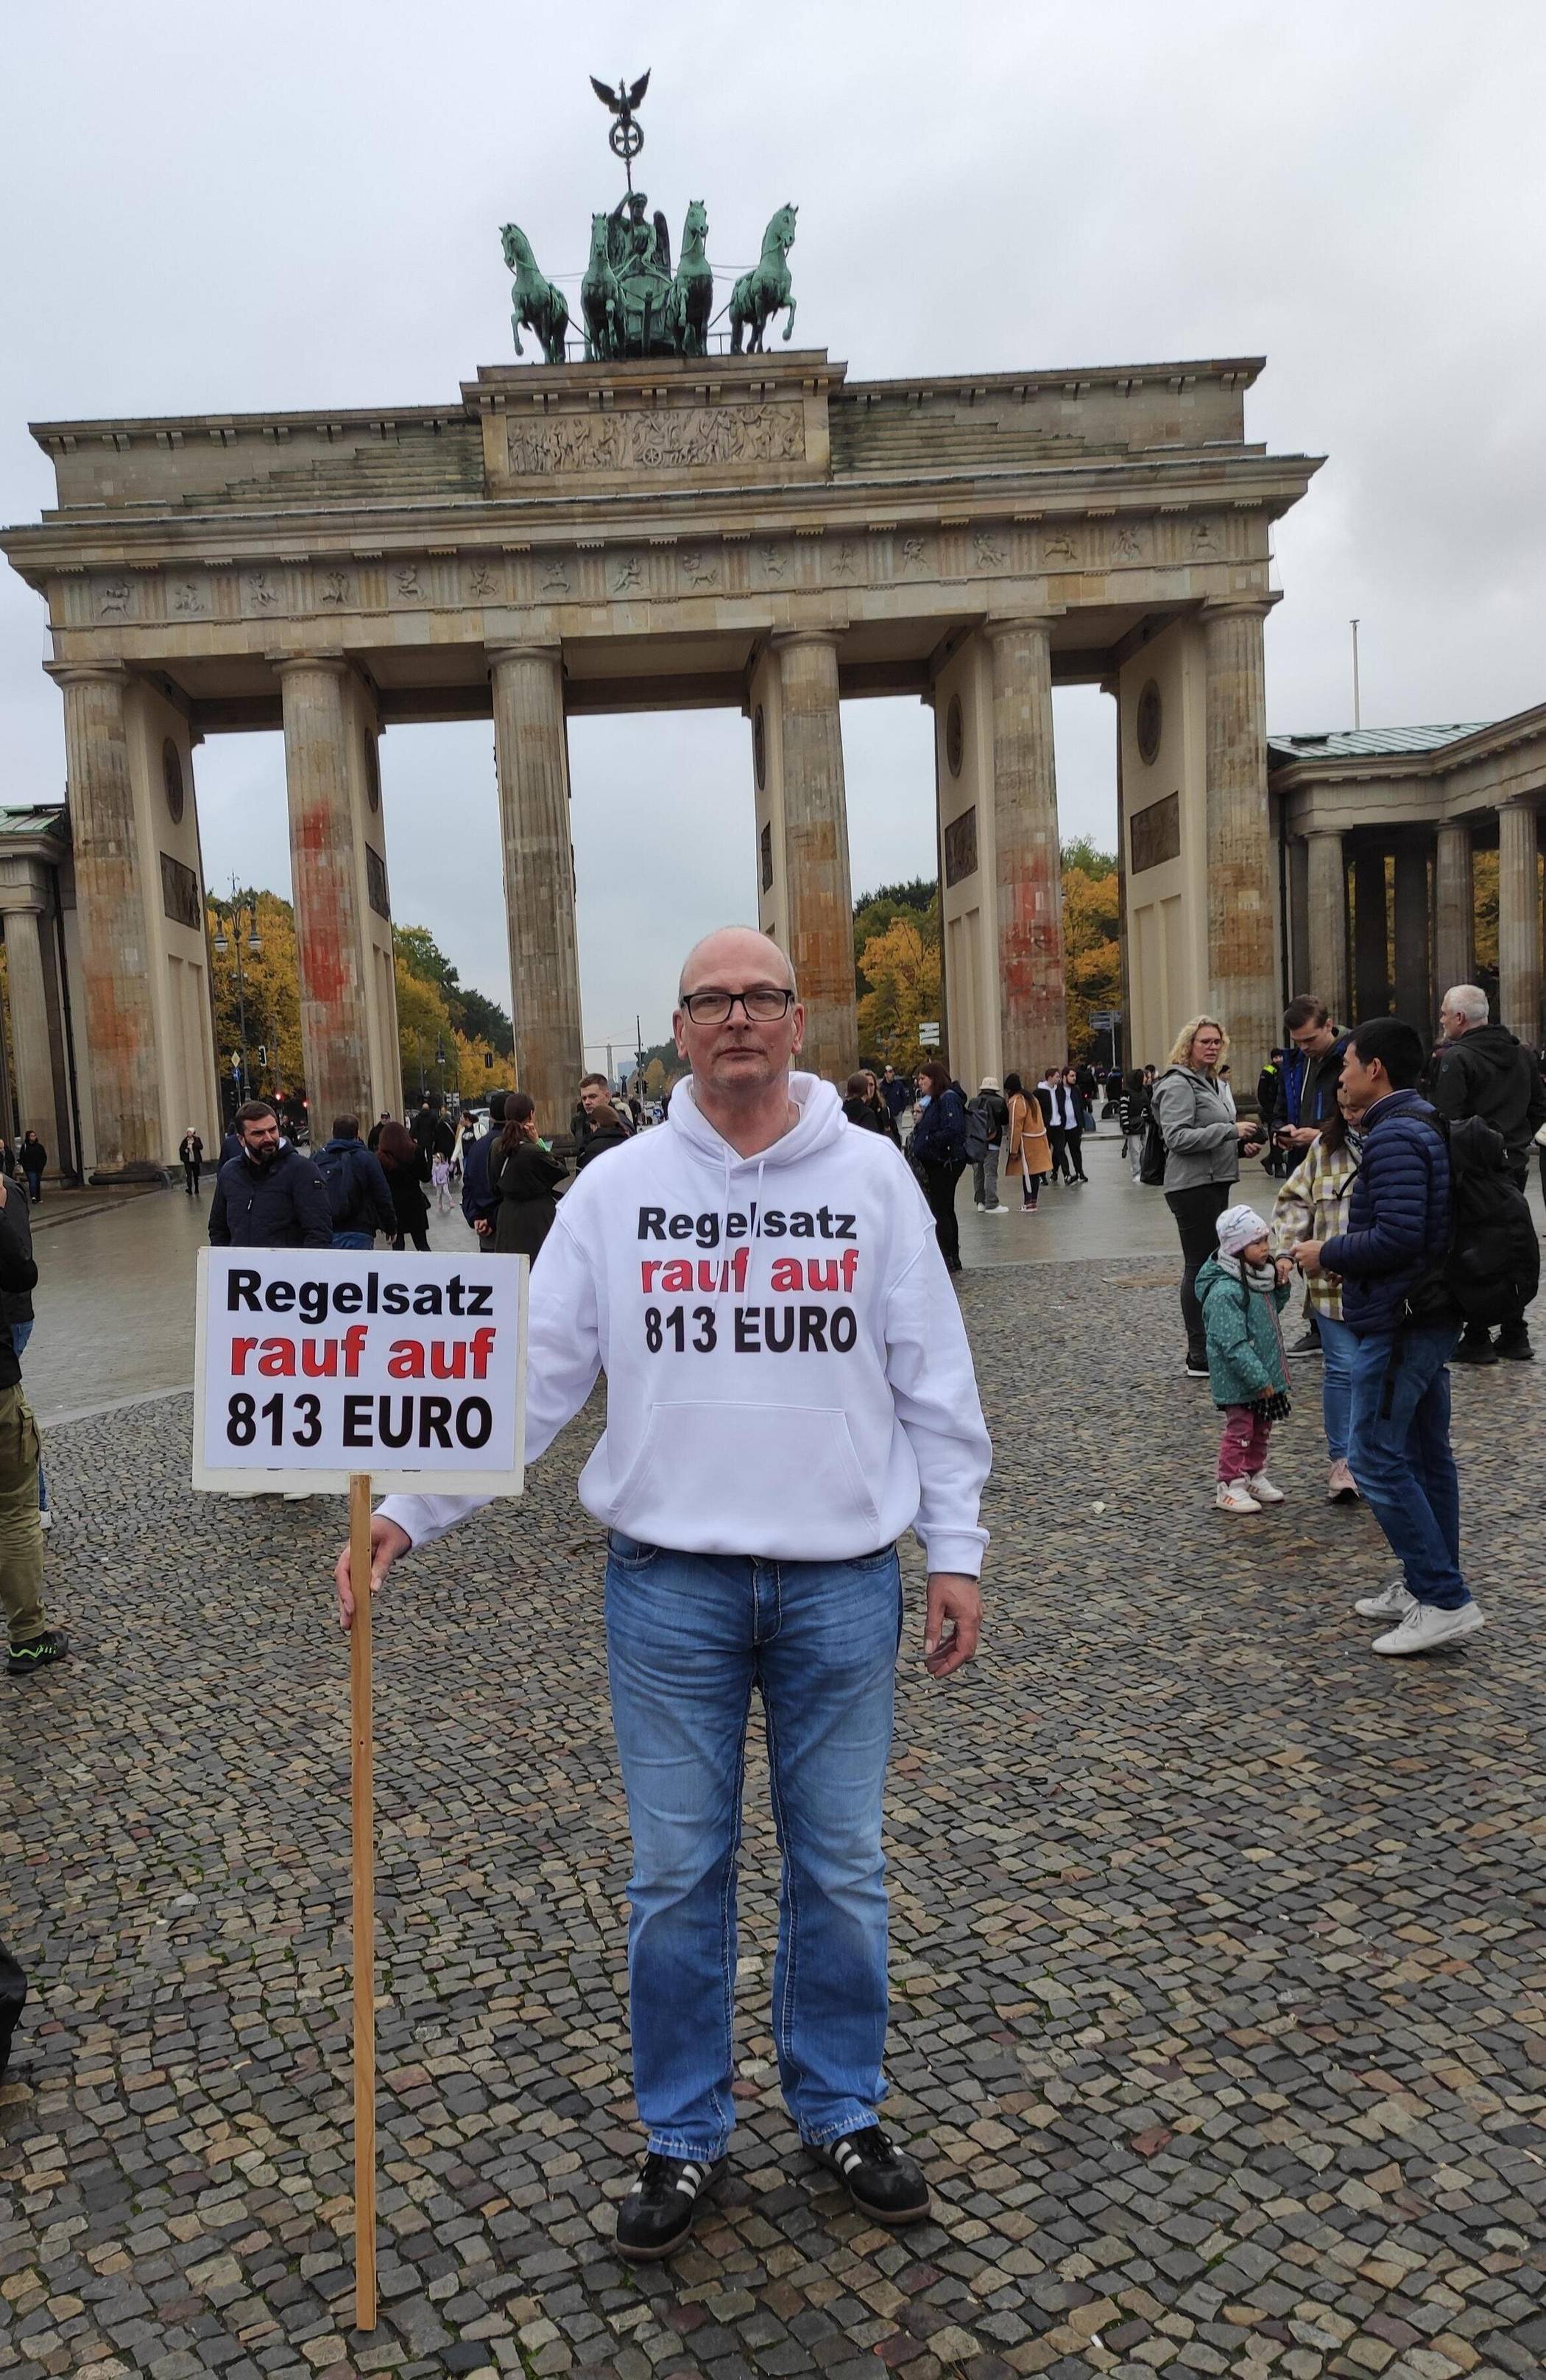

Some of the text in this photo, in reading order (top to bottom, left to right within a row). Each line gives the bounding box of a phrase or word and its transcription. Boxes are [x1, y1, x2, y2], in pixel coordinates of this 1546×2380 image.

[638, 1202, 857, 1248] Regelsatz
[641, 1247, 859, 1293] rauf auf
[227, 1269, 493, 1324] Regelsatz
[231, 1325, 496, 1379] rauf auf
[645, 1306, 857, 1353] 813 EURO
[226, 1393, 493, 1449] 813 EURO
